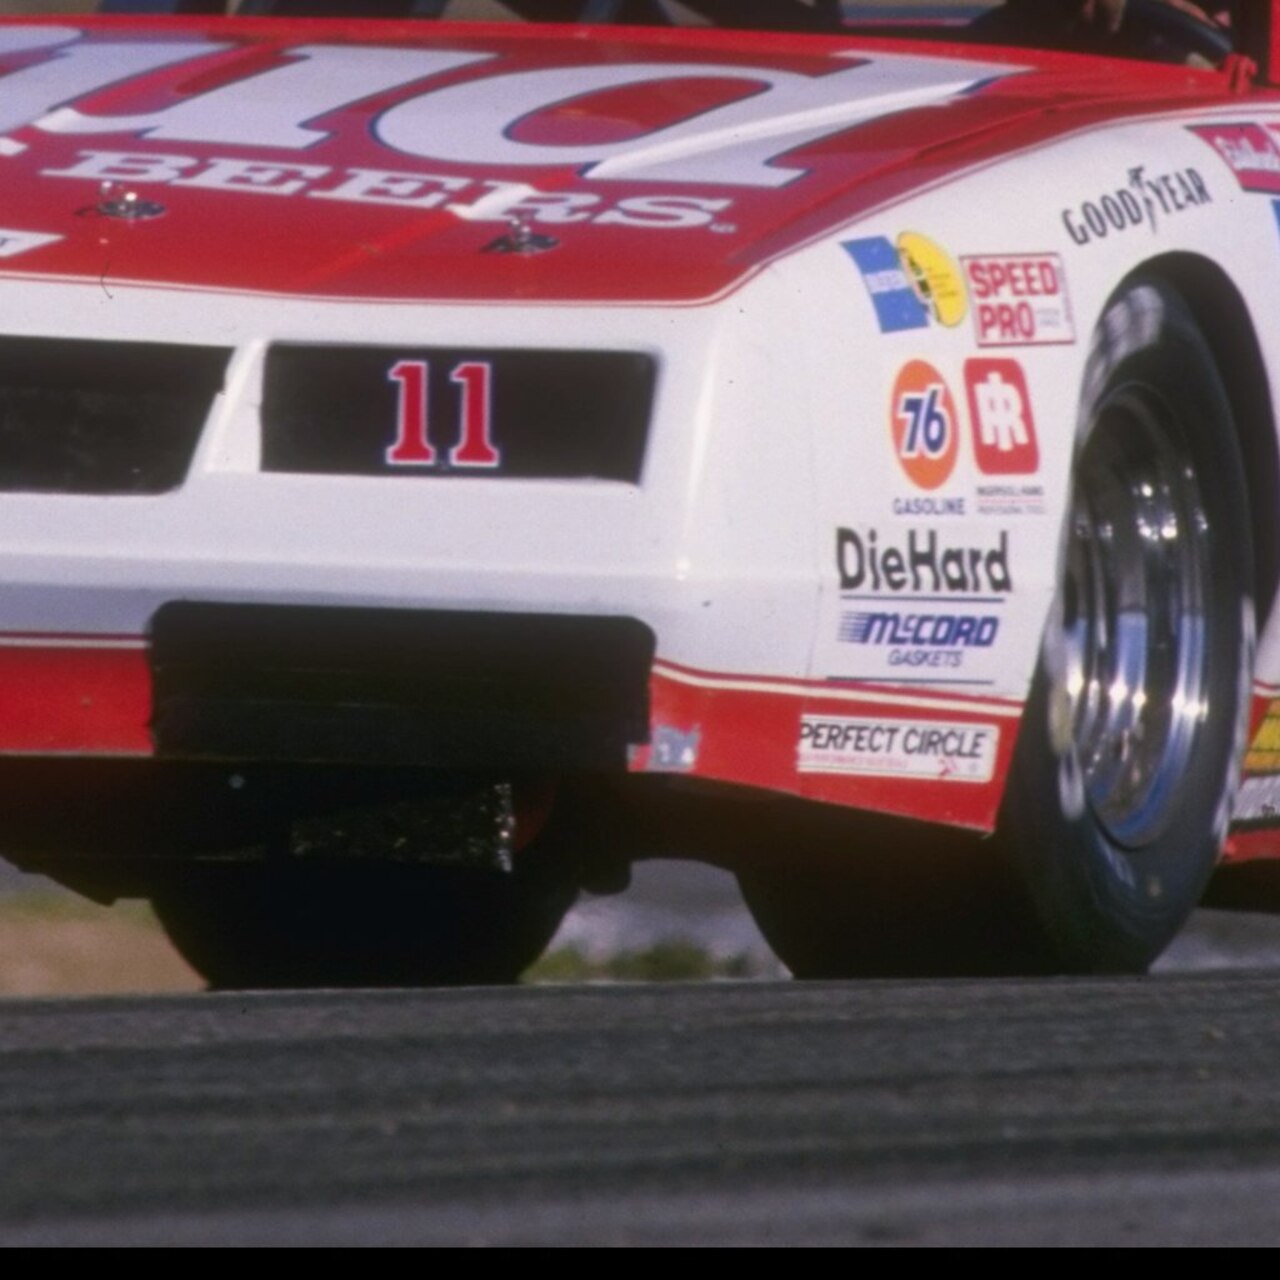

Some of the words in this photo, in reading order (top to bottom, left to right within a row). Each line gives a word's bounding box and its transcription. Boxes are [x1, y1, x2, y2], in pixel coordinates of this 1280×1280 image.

[1061, 166, 1213, 246] GOODYEAR
[969, 261, 1058, 299] SPEED
[978, 304, 1037, 341] PRO
[387, 362, 499, 468] 11
[900, 388, 948, 454] 76
[893, 497, 966, 516] GASOLINE
[836, 527, 1013, 592] DieHard
[889, 650, 964, 668] GASKETS
[800, 722, 900, 752] PERFECT
[902, 729, 987, 758] CIRCLE
